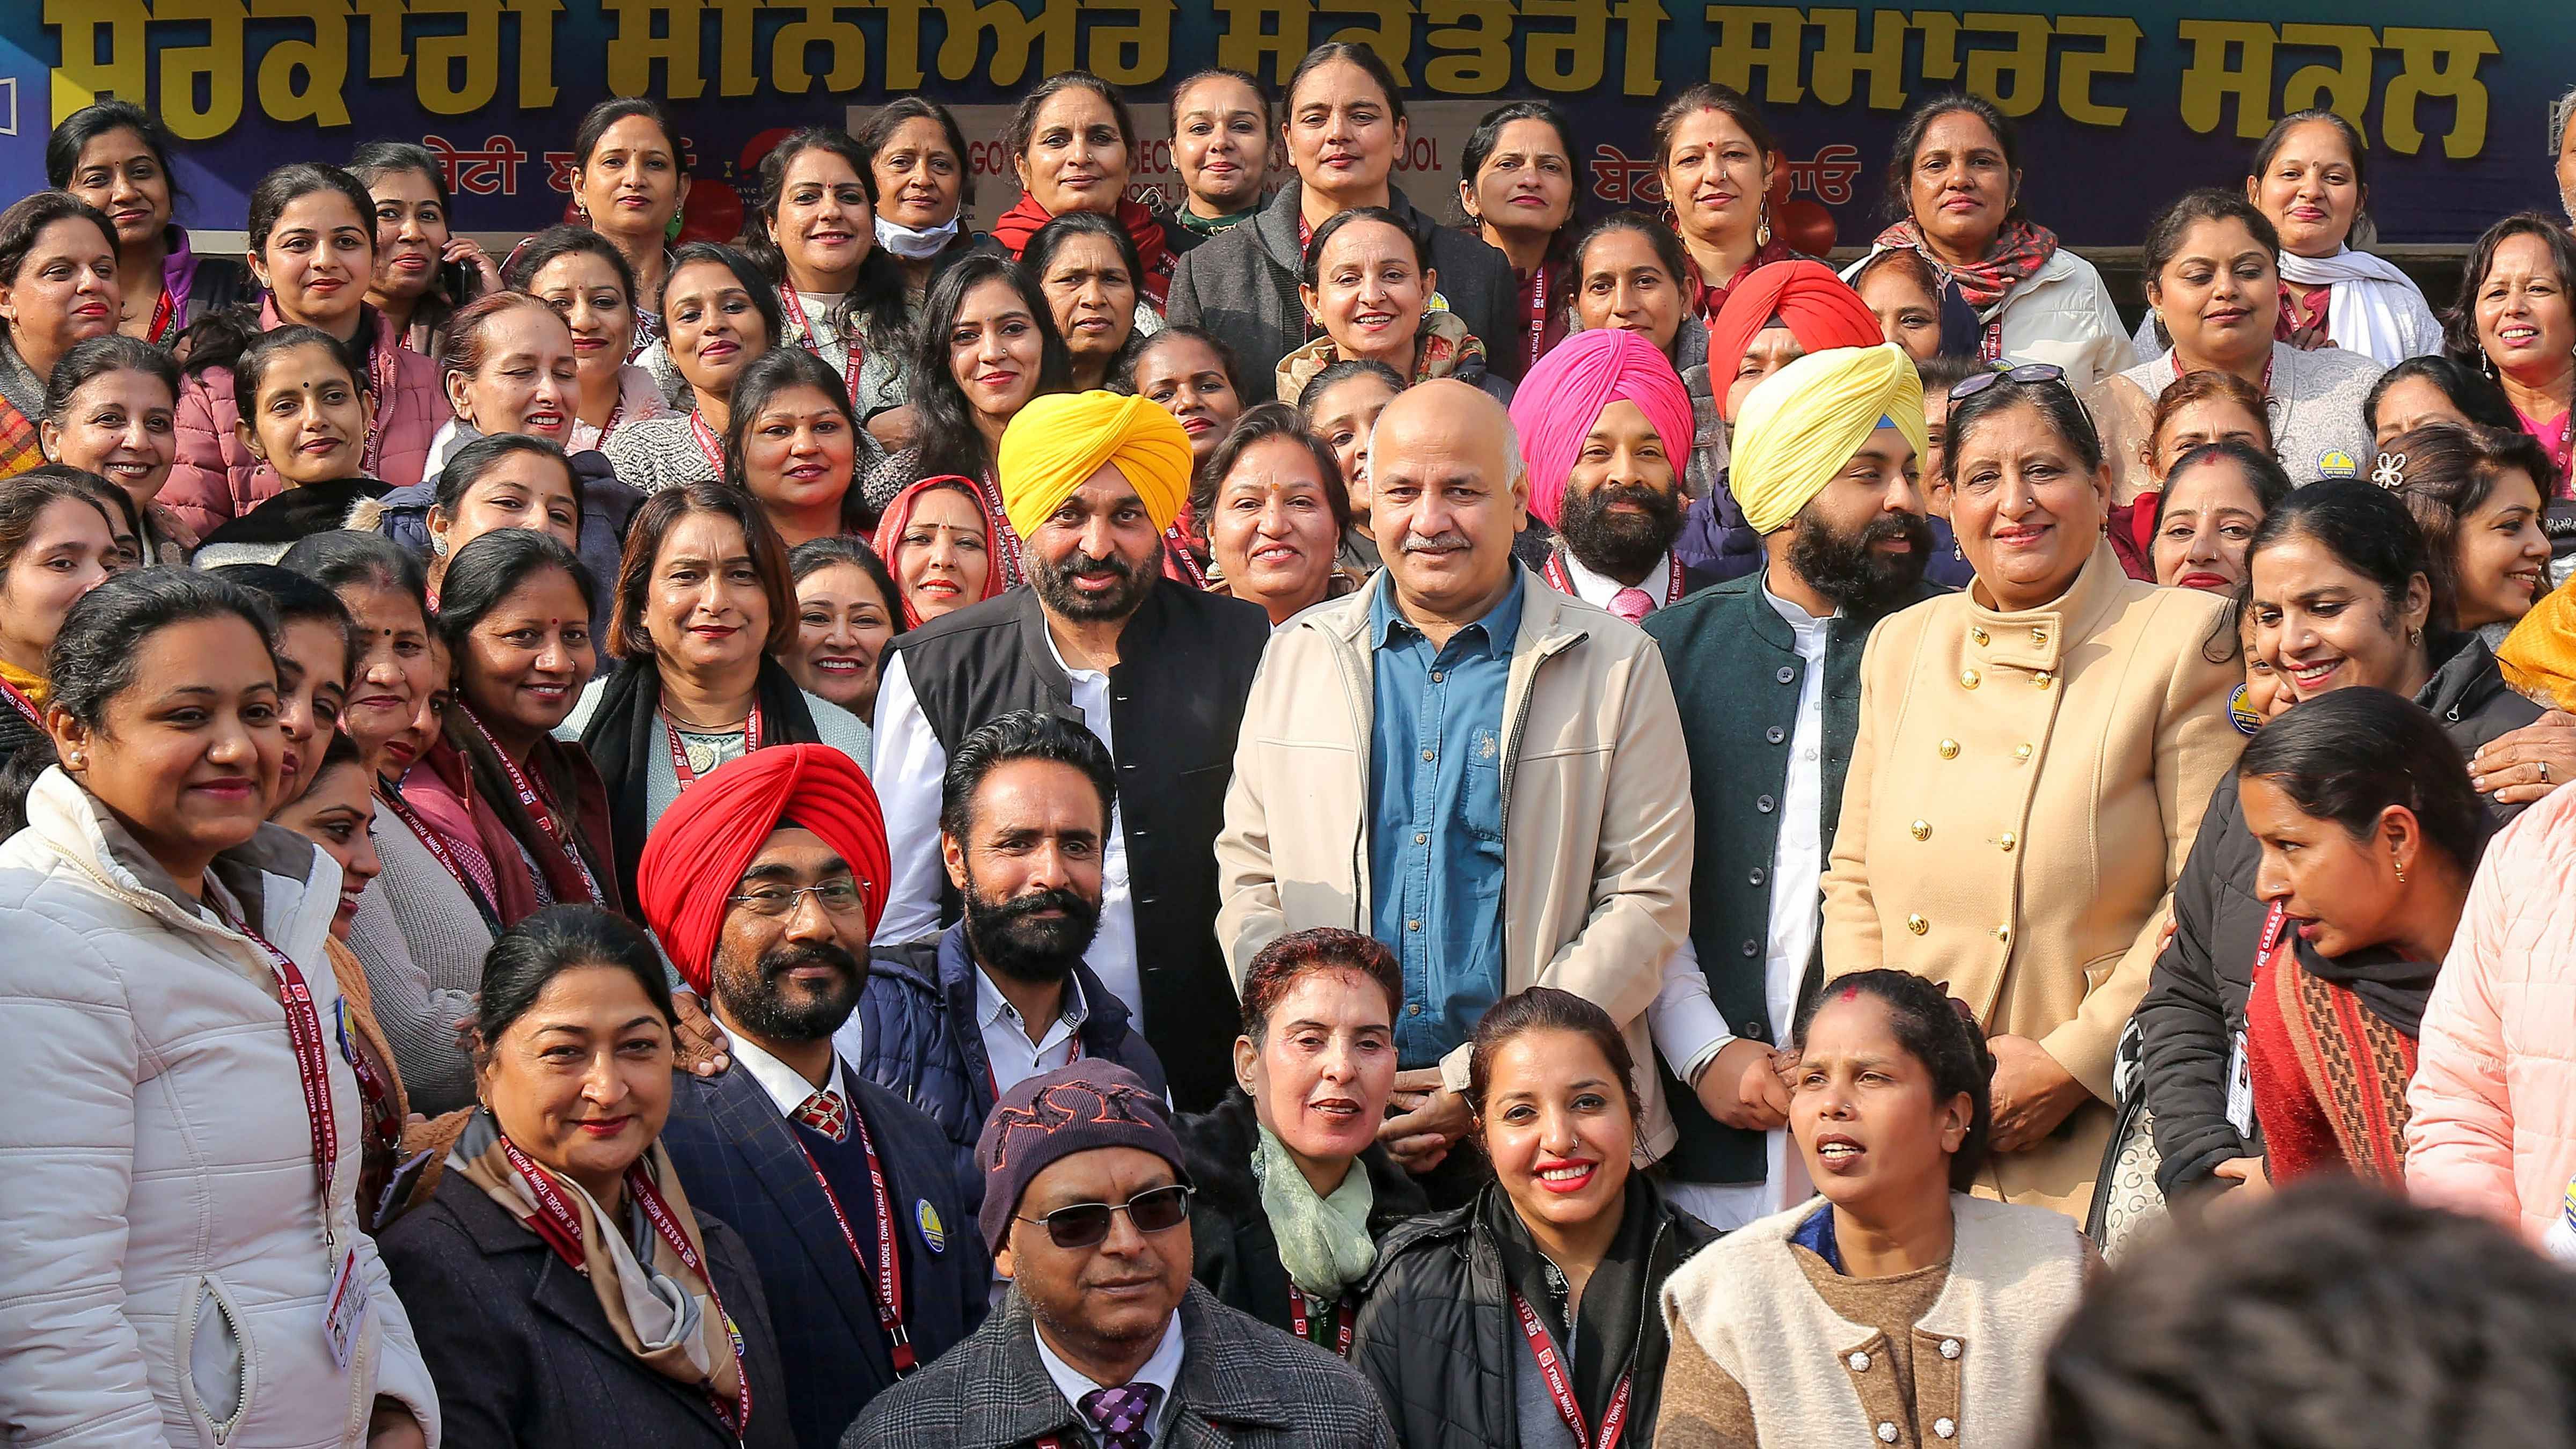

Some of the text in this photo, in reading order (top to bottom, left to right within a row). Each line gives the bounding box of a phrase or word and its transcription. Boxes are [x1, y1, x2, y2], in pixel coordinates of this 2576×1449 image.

[1707, 4, 2144, 127] ਸਮਾਰਟ
[2179, 19, 2501, 159] ਸਕਲ
[492, 741, 509, 762] MODEL
[404, 811, 458, 876] MODEL TOWN, PATIALA
[288, 1007, 301, 1046] PATIALA
[303, 1004, 318, 1044] PATIALA
[306, 1083, 317, 1113] MODEL
[317, 1078, 328, 1111] MODEL
[507, 1146, 531, 1173] PATIALA
[545, 1190, 569, 1222] MODEL
[643, 1194, 663, 1220] MODEL
[881, 1241, 891, 1268] MODEL
[1547, 1365, 1566, 1395] PATIALA
[1570, 1417, 1586, 1444] MODEL
